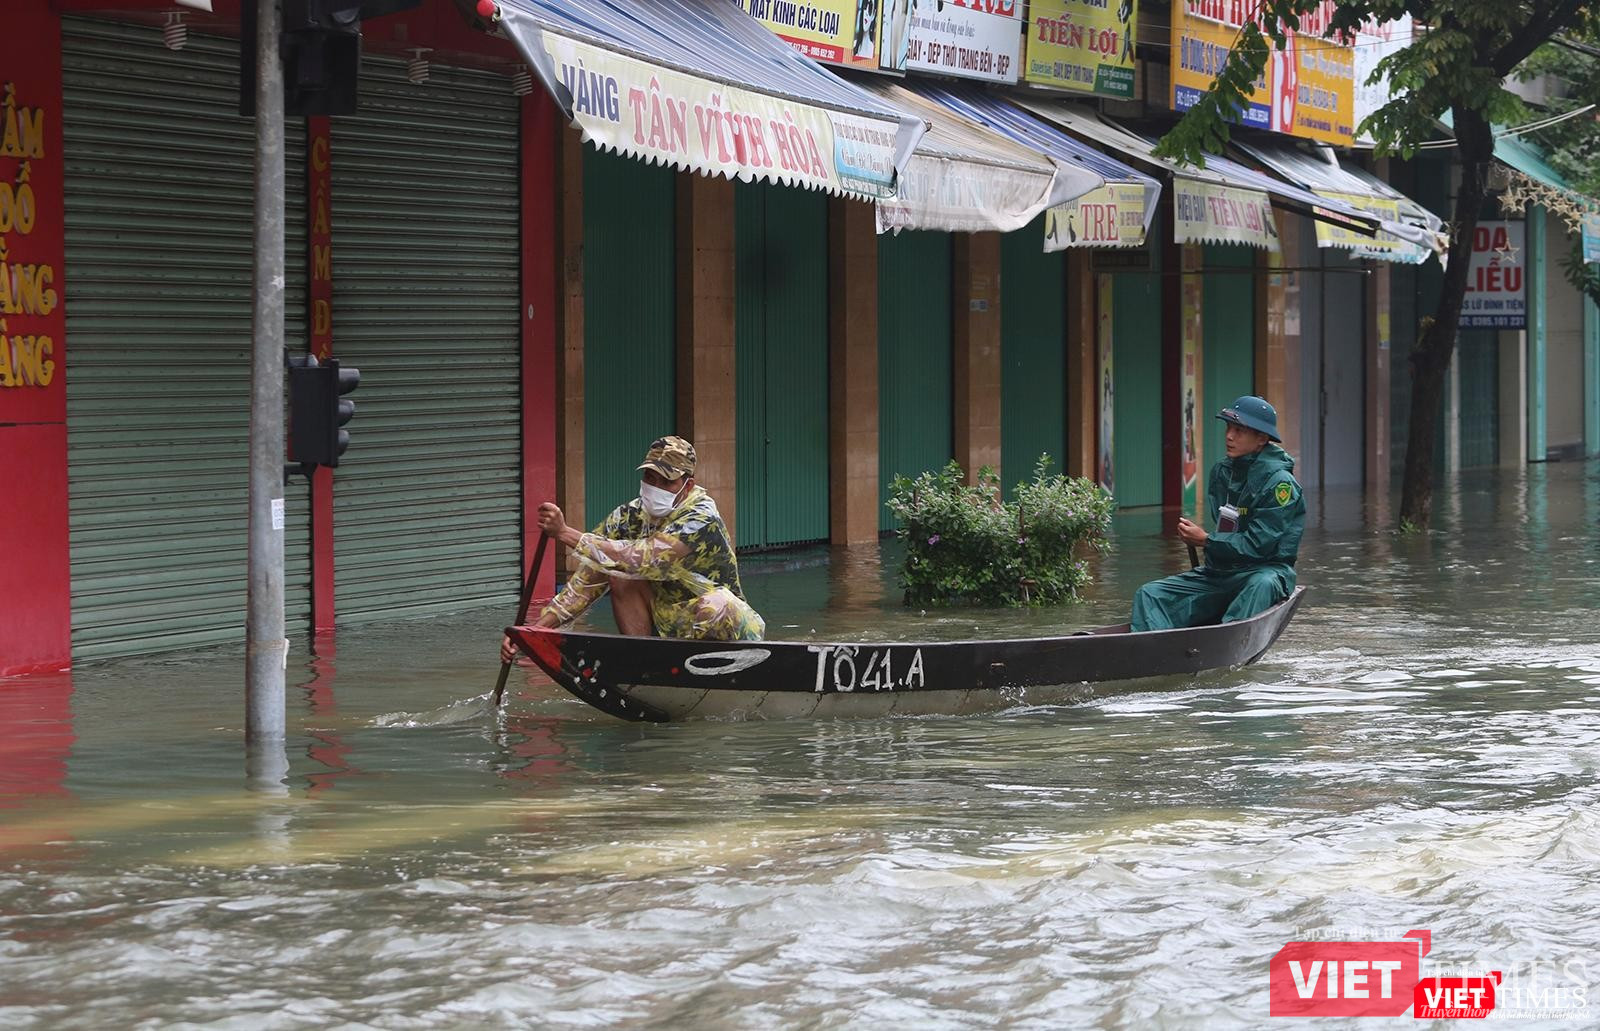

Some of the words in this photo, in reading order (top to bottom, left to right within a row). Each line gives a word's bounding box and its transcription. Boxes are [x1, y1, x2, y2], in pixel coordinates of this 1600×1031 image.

[958, 48, 979, 71] TRANG
[562, 58, 620, 122] VÀNG
[628, 76, 687, 155] TÂN
[770, 110, 828, 179] HÒA
[1472, 226, 1511, 253] DA
